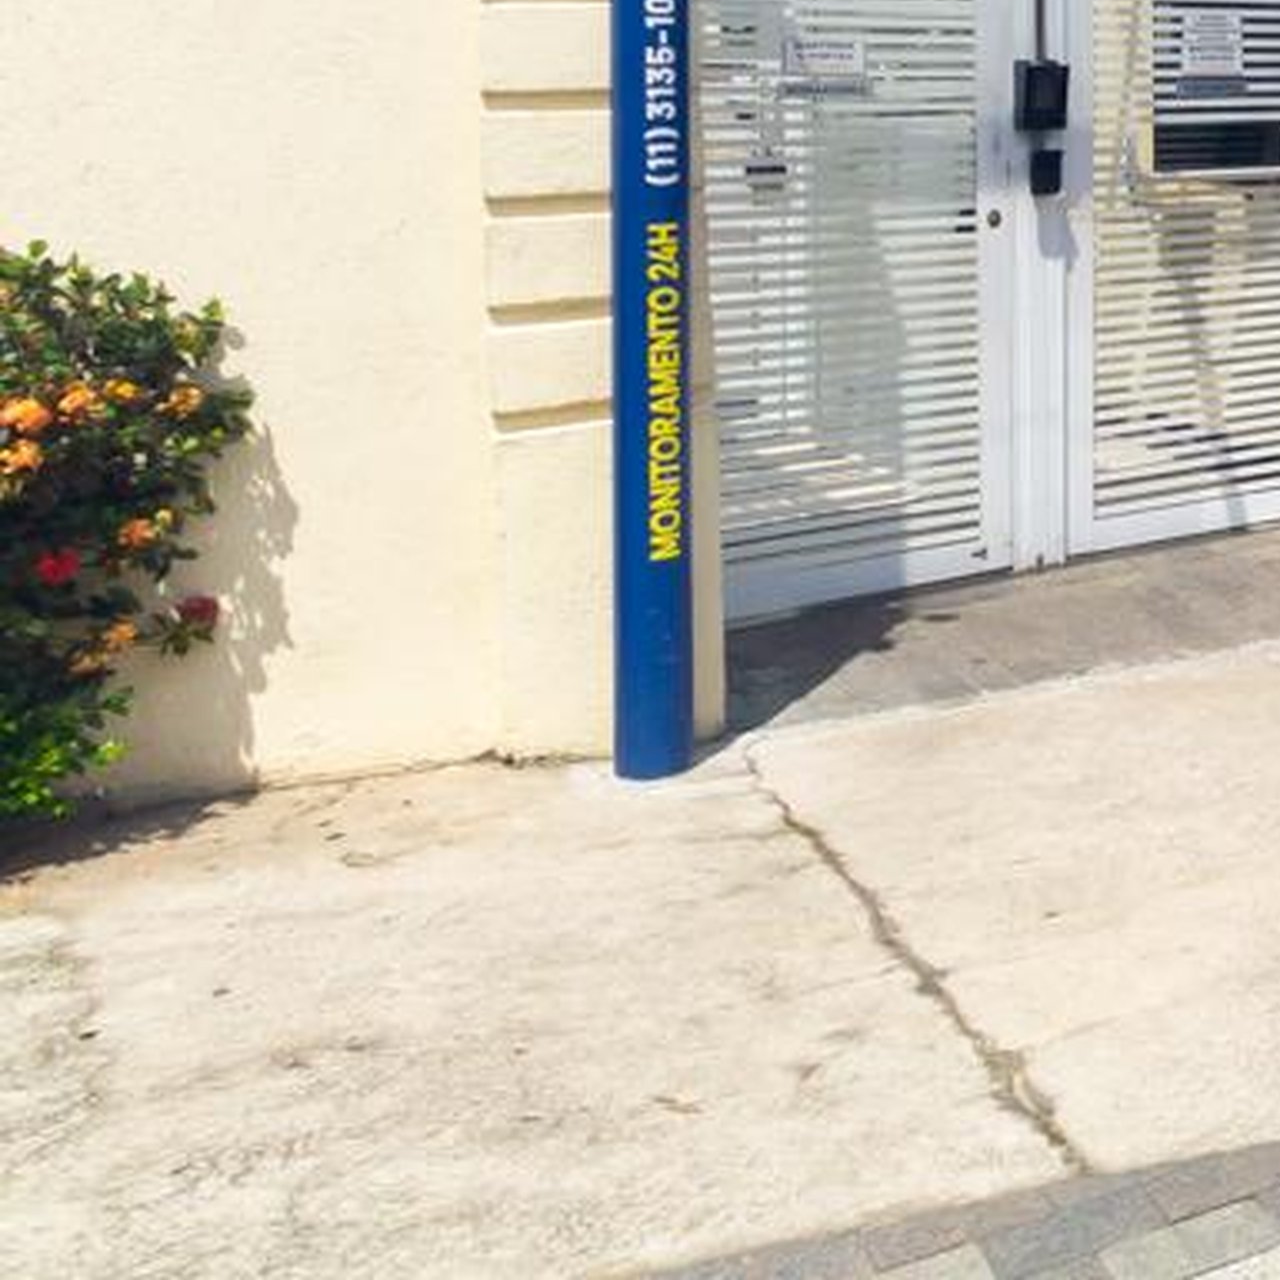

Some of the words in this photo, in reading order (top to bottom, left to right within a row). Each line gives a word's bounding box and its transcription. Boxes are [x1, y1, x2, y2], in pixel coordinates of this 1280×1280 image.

[643, 126, 680, 187] (11)
[646, 221, 681, 280] 24H
[646, 286, 683, 562] MONITORAMENTO
